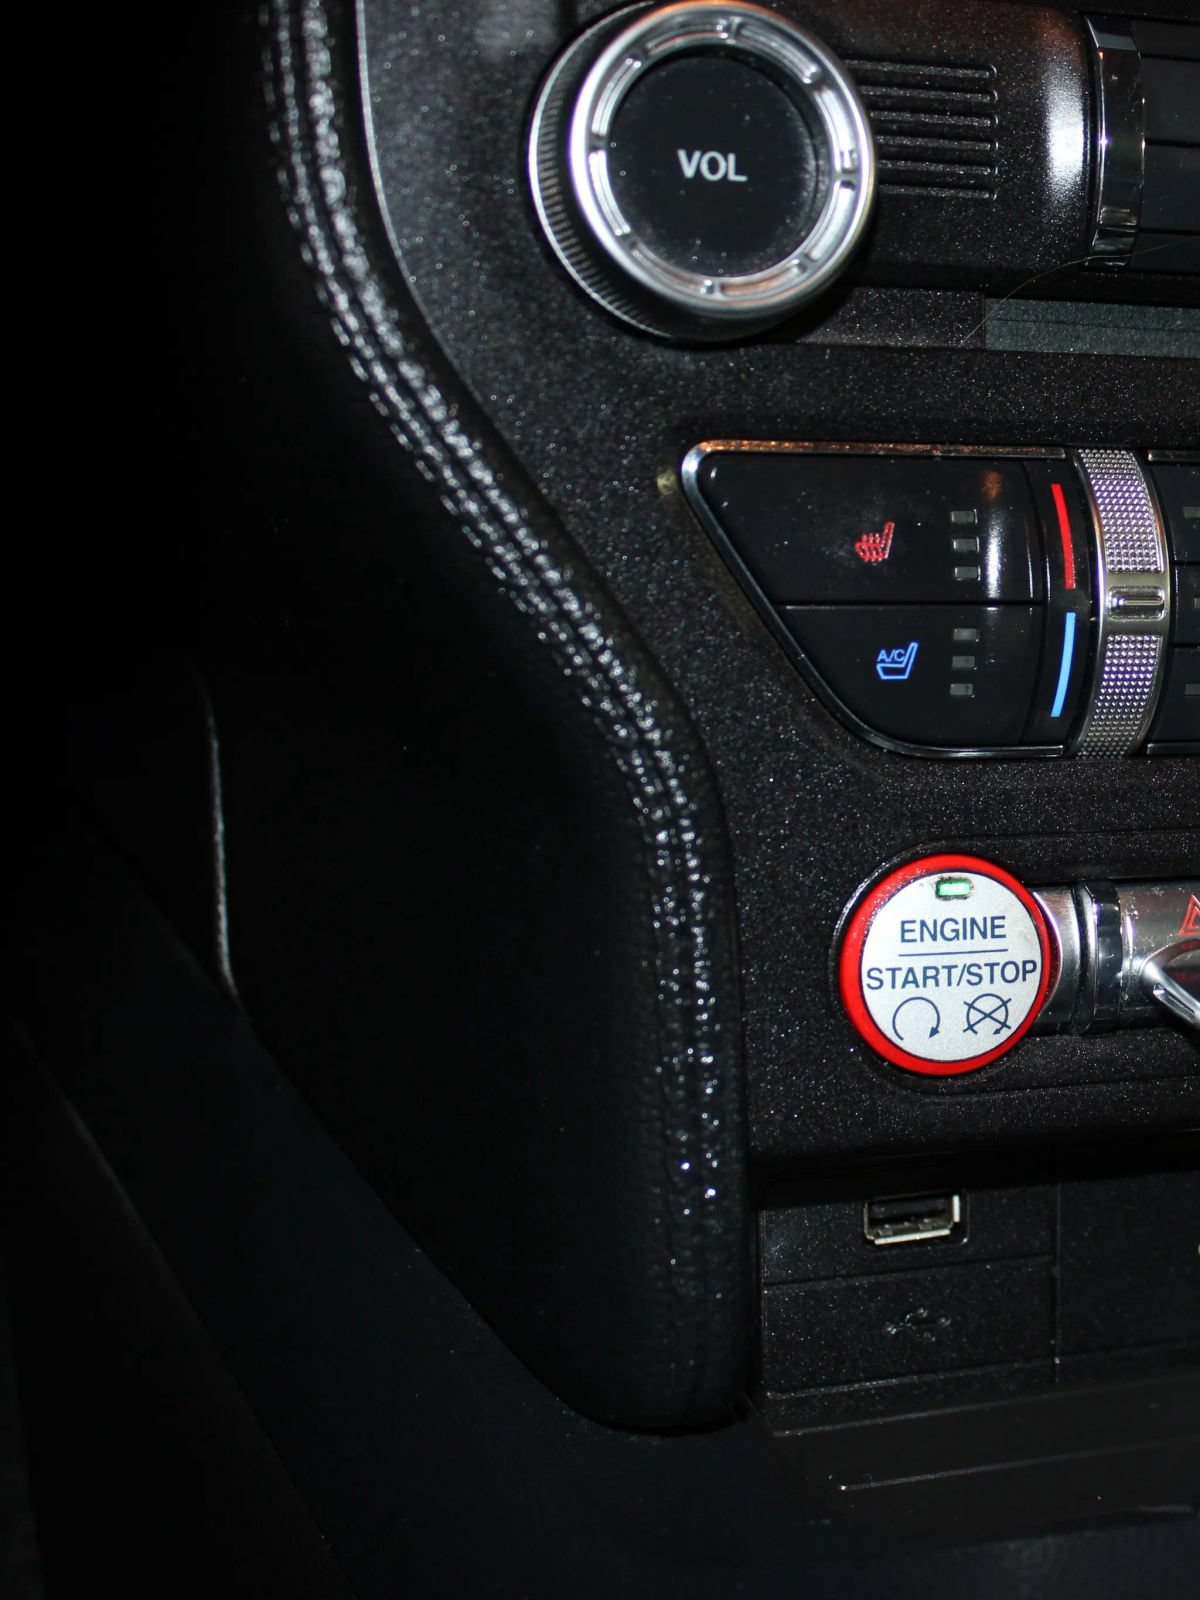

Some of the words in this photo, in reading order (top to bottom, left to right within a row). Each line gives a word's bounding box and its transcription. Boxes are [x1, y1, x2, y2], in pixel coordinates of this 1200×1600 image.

[677, 149, 748, 183] VOL
[877, 649, 905, 662] A/C
[899, 915, 1008, 944] ENGINE
[866, 958, 1039, 991] START/STOP
